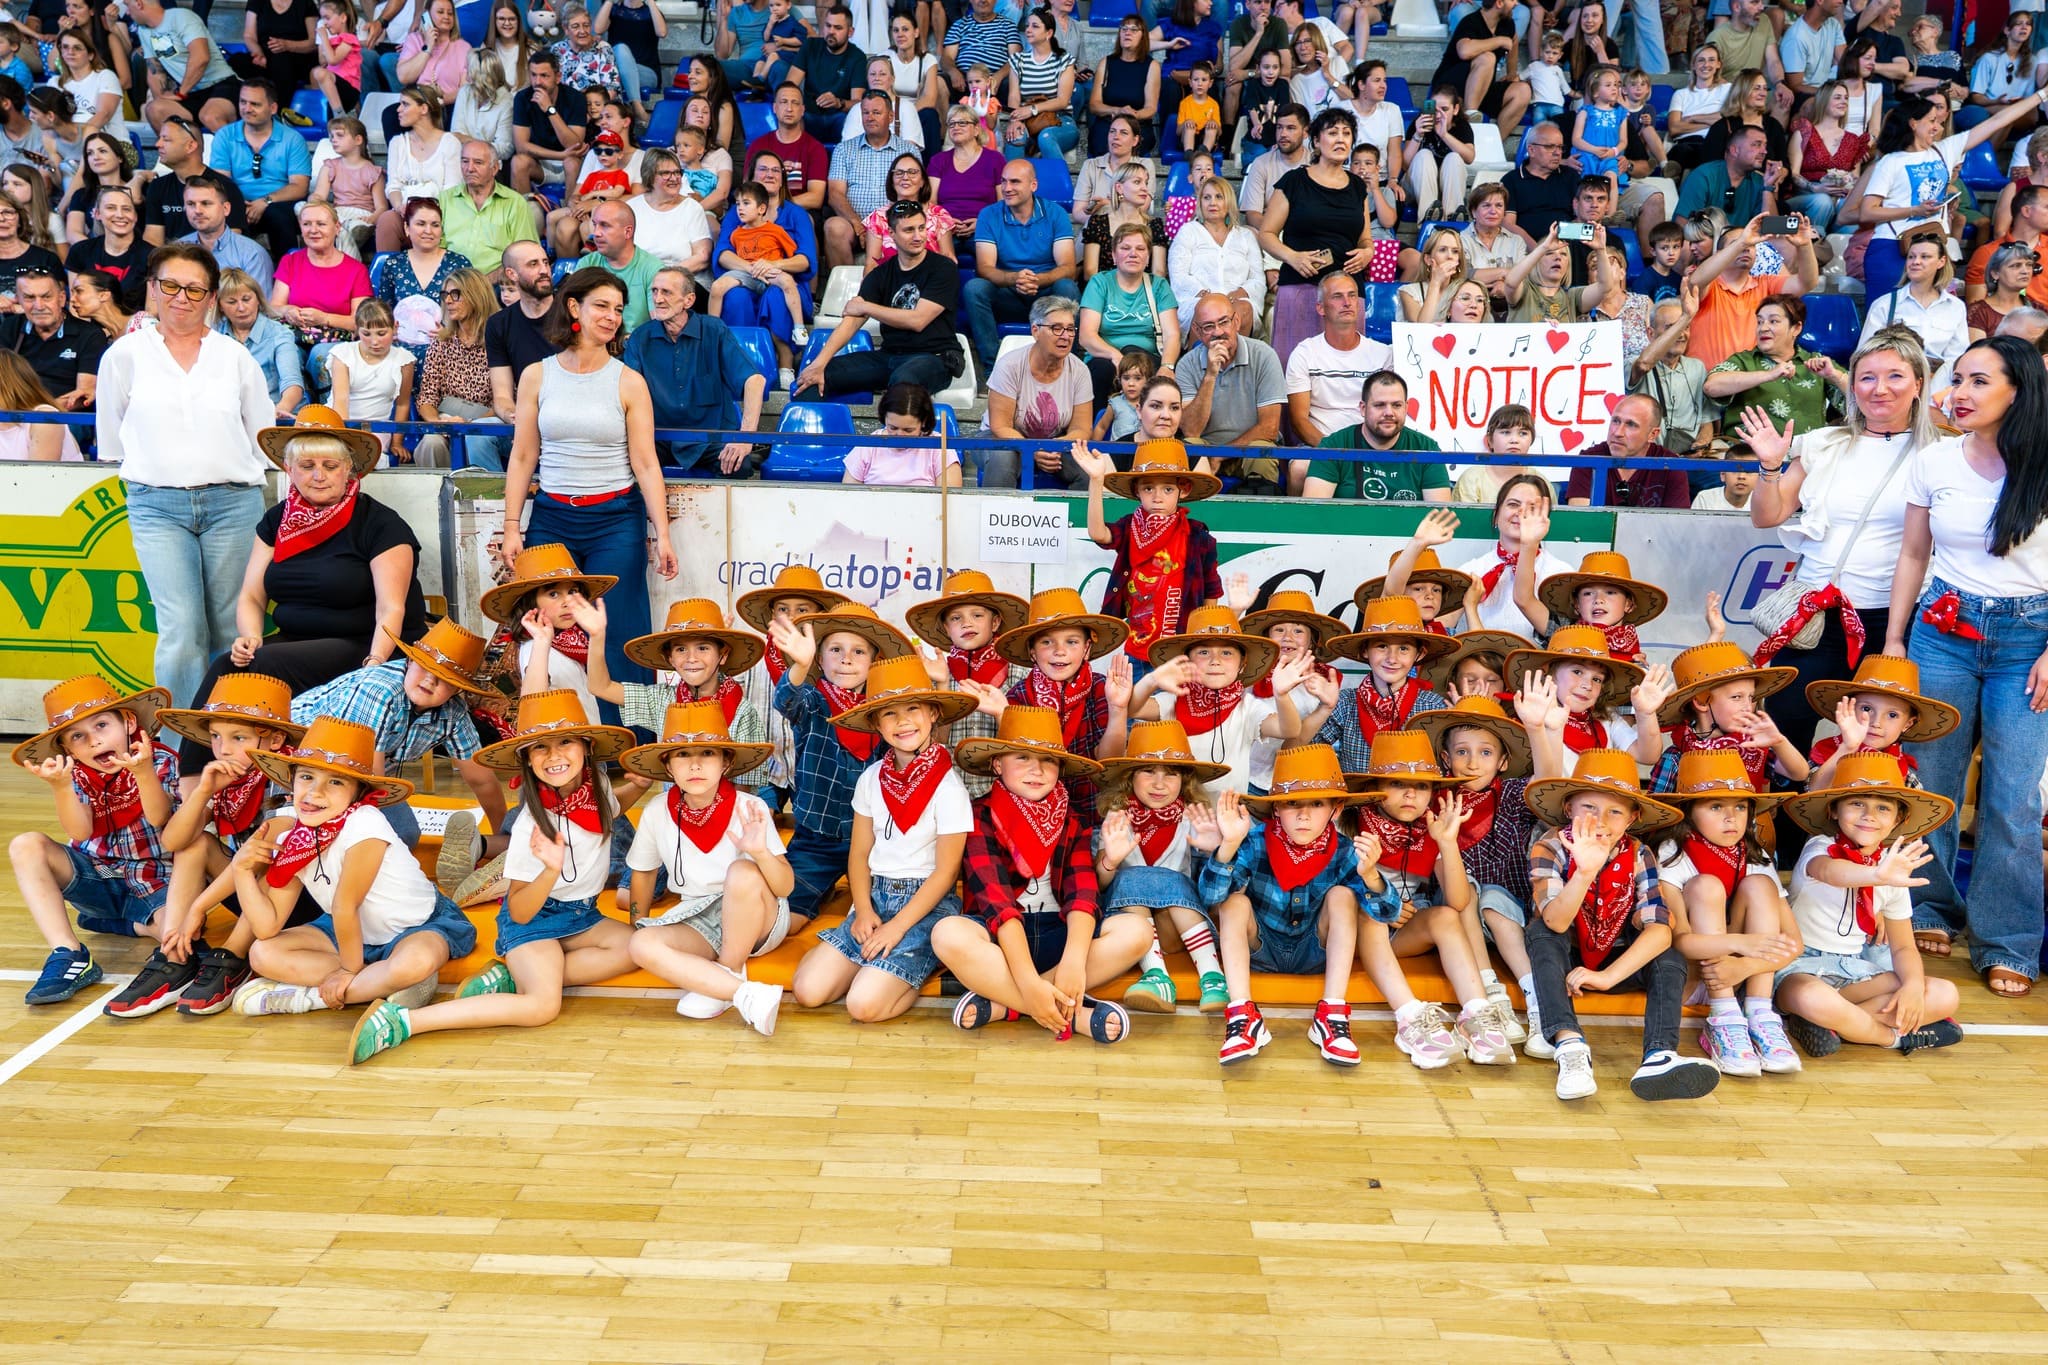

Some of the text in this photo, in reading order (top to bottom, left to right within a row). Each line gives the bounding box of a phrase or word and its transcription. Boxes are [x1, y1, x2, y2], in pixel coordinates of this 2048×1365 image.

[1429, 363, 1613, 431] NOTICE
[989, 513, 1061, 528] DUBOVAC
[988, 536, 1059, 548] STARS I LAVIĆI
